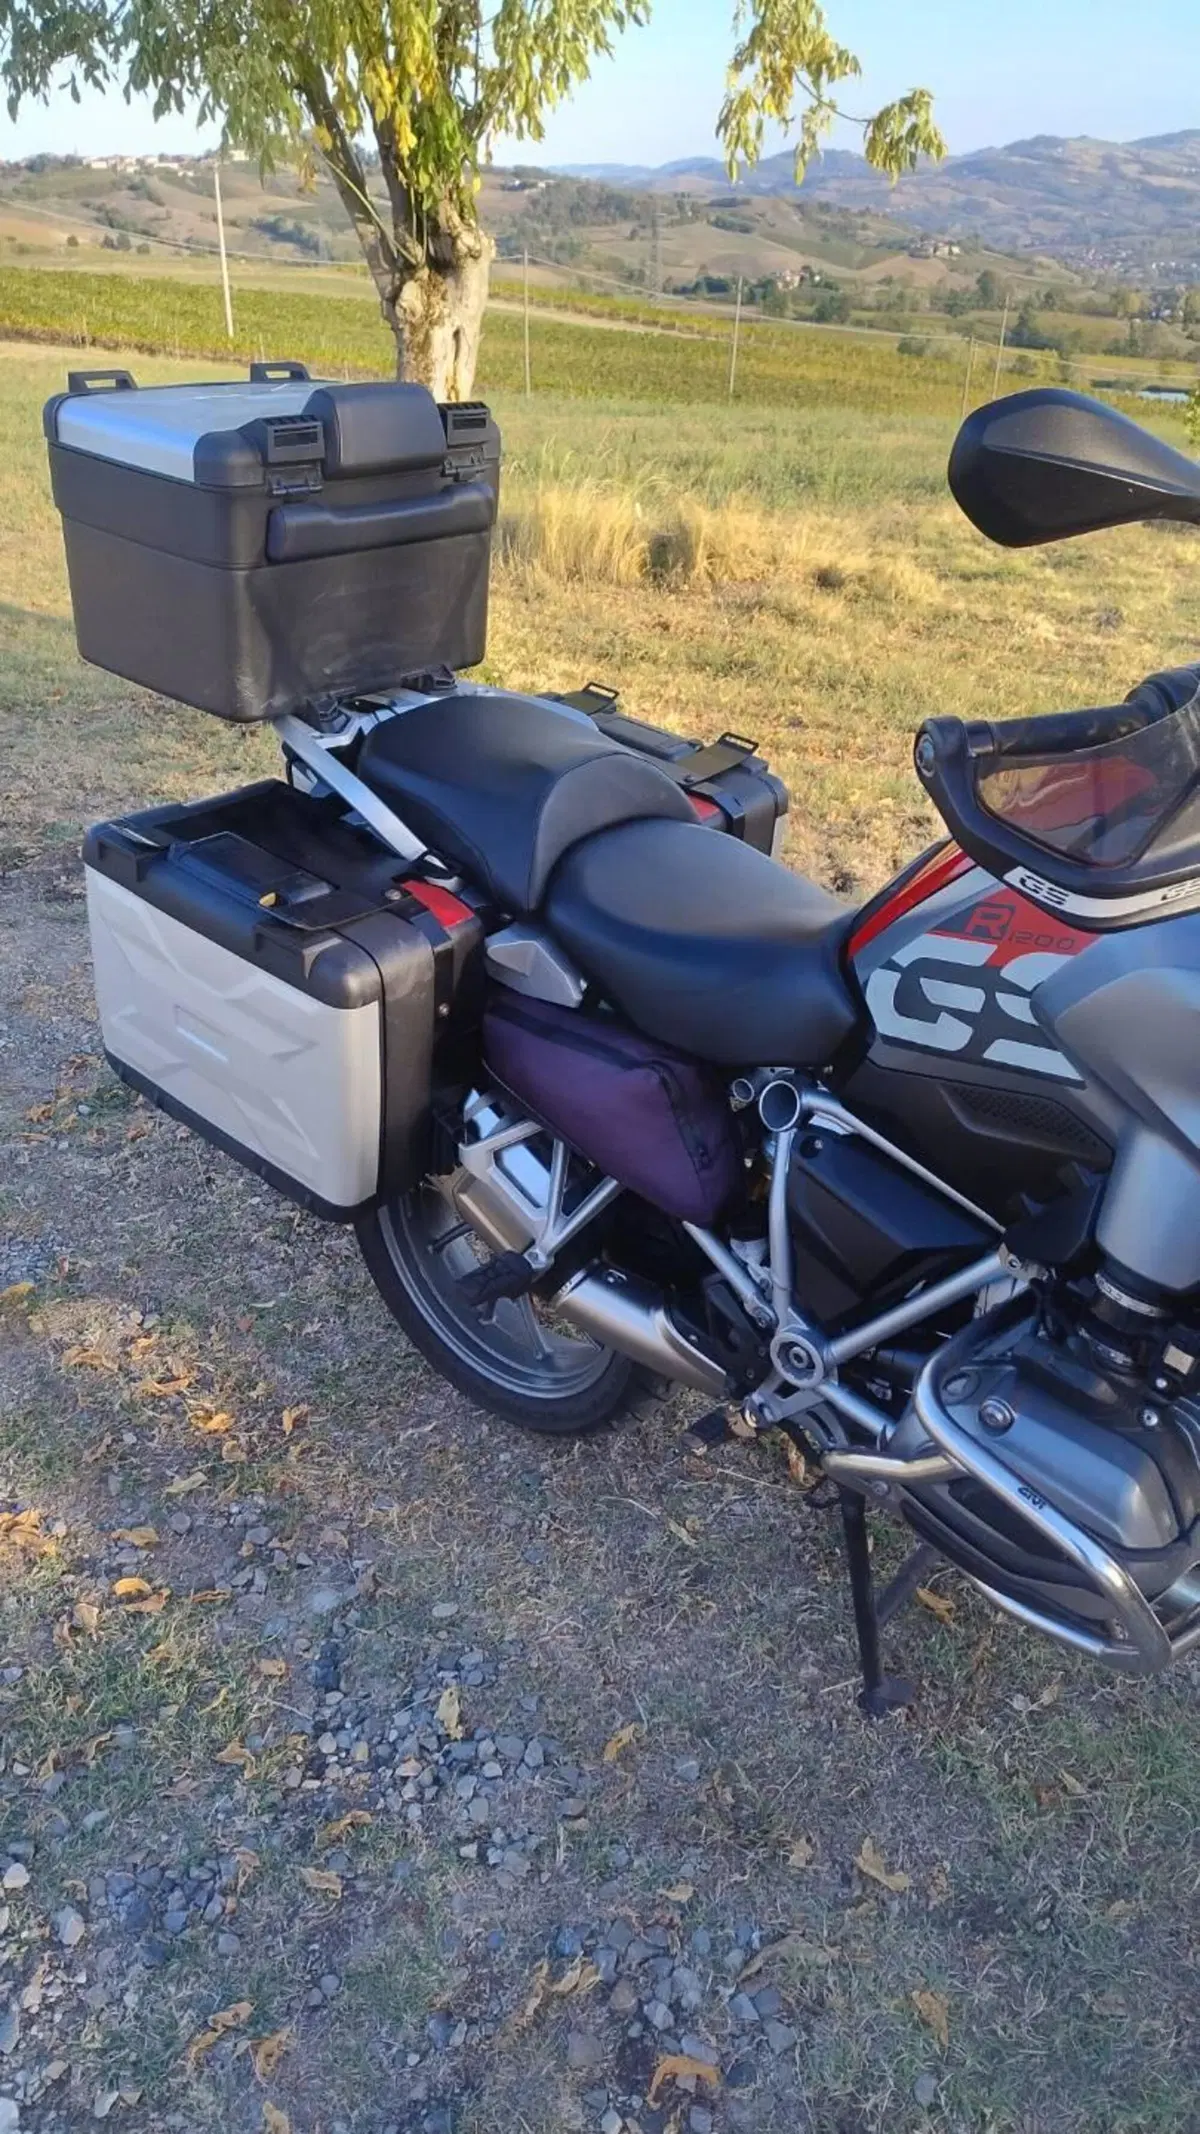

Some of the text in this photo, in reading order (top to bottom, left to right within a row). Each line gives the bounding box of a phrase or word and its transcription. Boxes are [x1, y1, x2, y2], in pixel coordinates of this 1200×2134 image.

[1019, 873, 1070, 906] GS
[964, 901, 1075, 951] R 1200
[866, 933, 1086, 1081] GS
